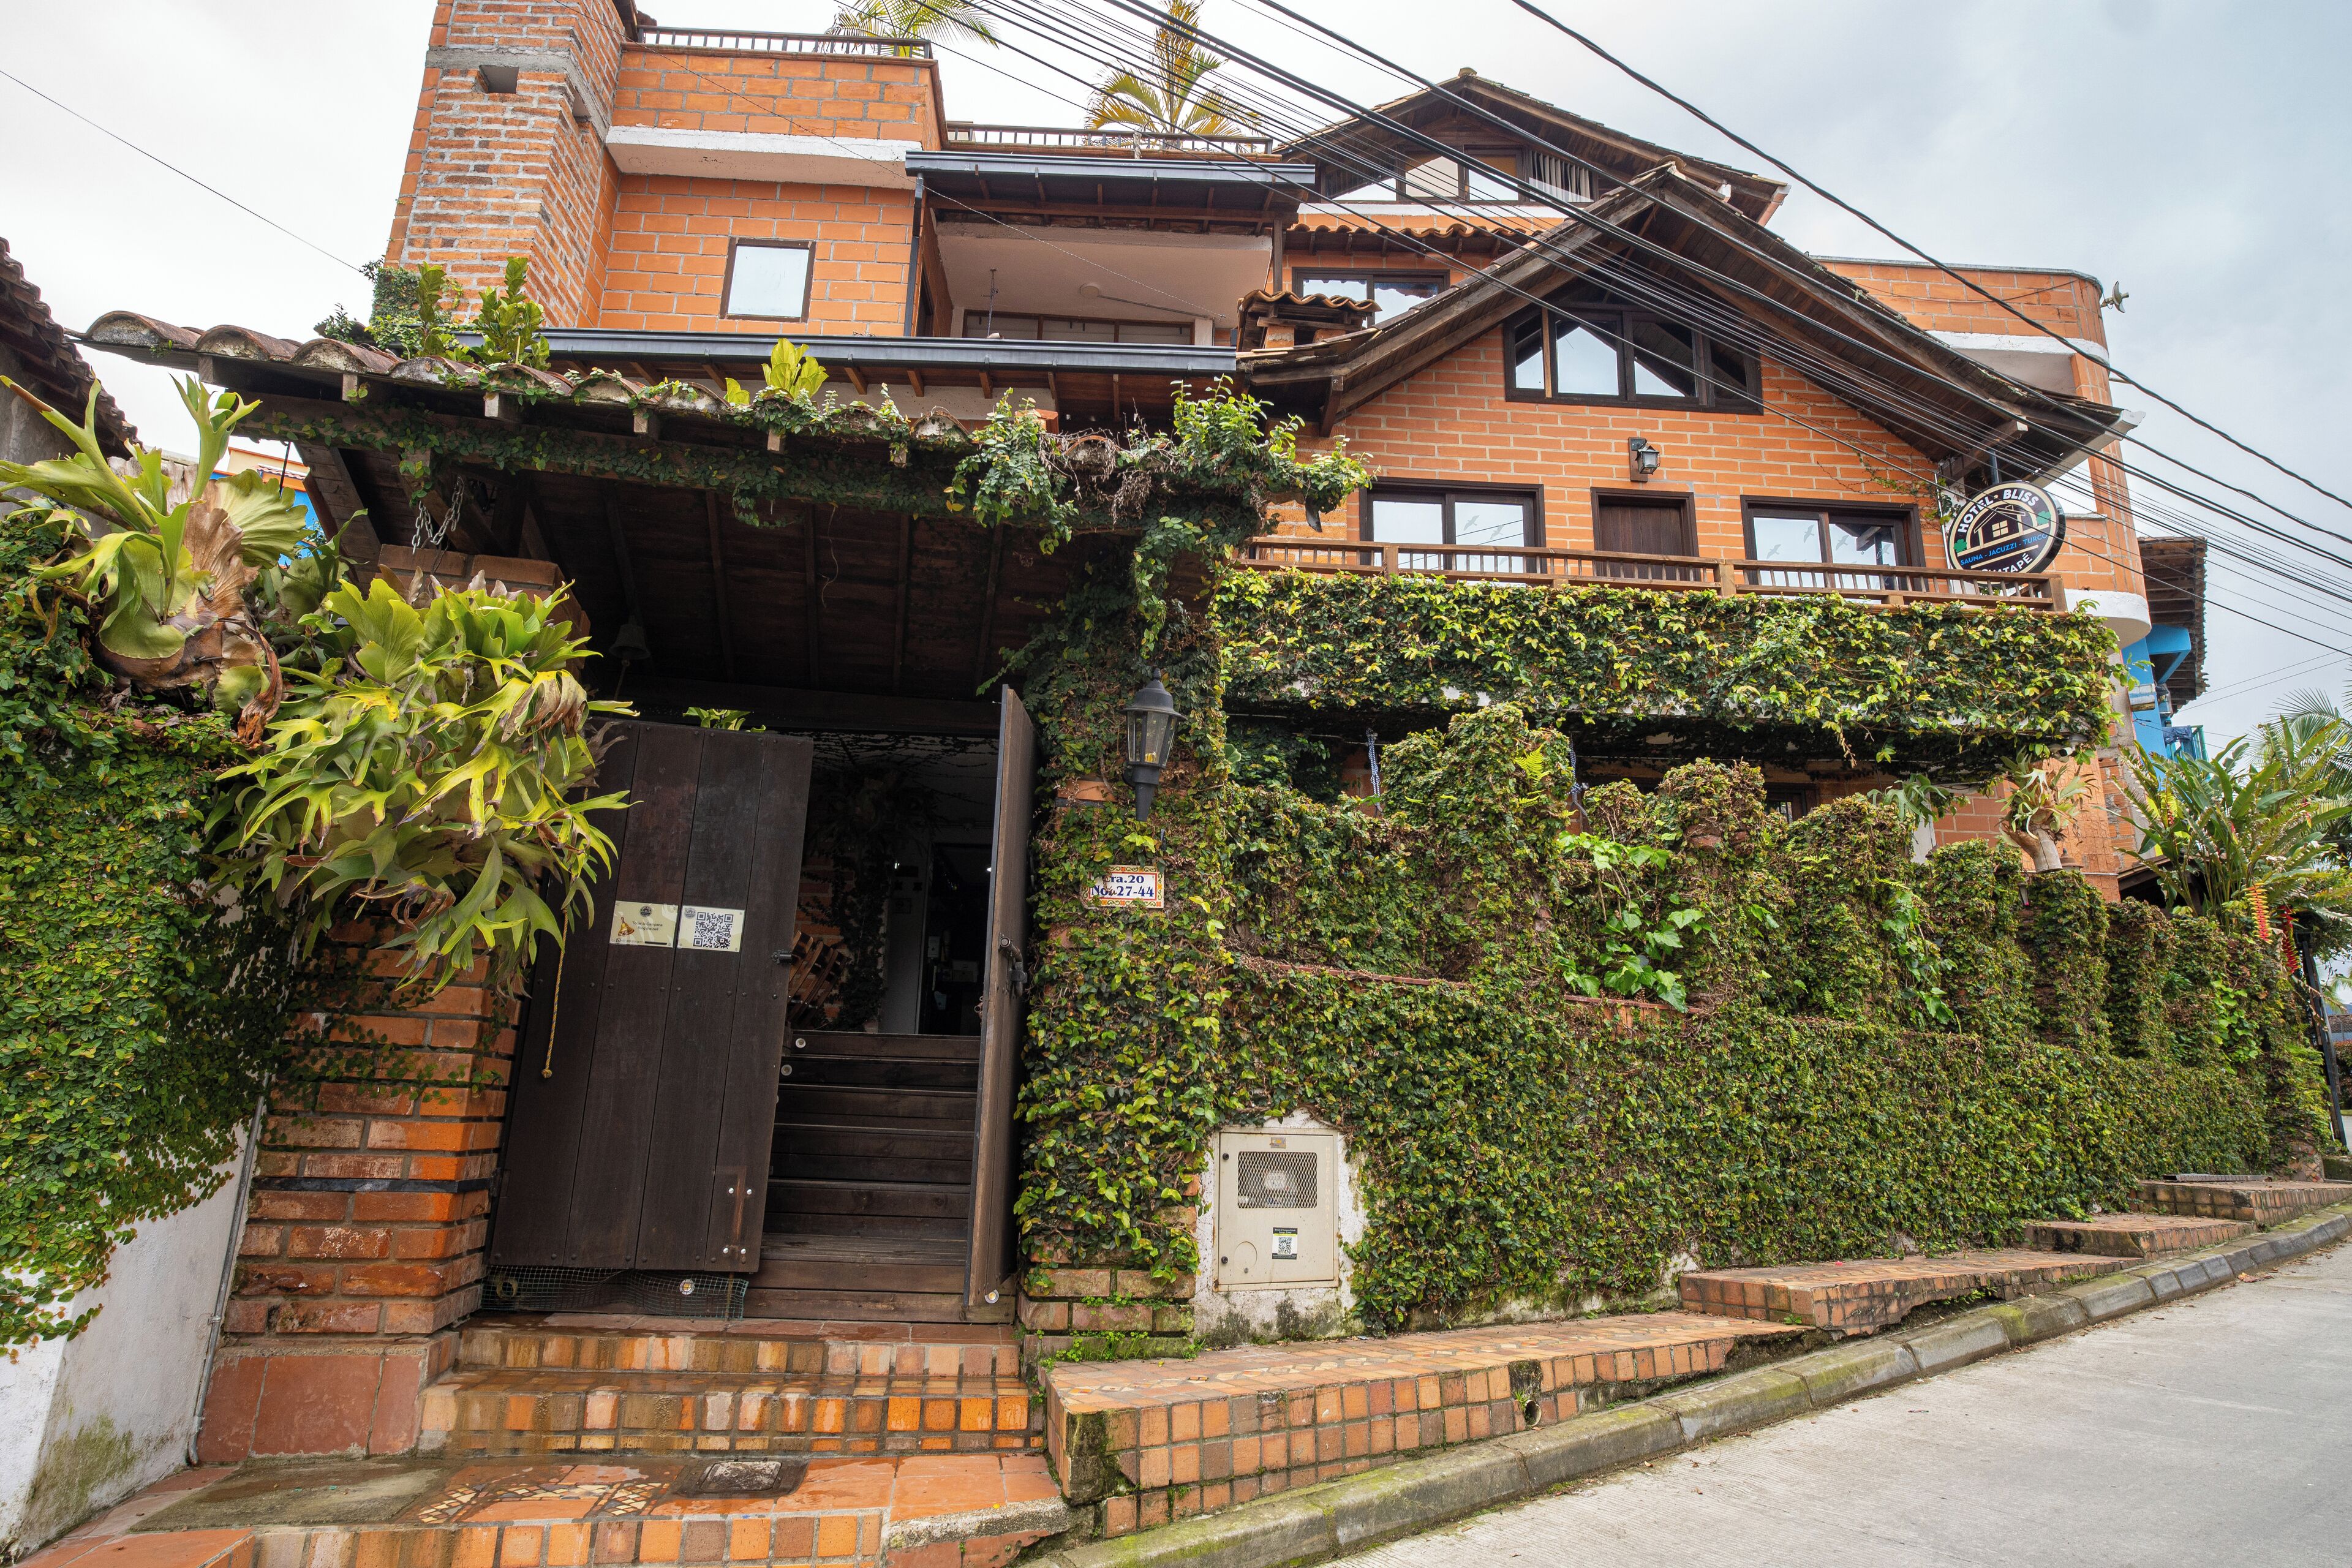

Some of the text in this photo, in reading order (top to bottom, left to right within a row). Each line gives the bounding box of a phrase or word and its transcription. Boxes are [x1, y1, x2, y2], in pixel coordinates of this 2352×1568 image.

[1957, 489, 2040, 533] HOTEL BLISS
[1960, 532, 2048, 566] SAUNA JACUZZI TURCO
[1981, 552, 2034, 573] TAPÉ
[1117, 886, 1155, 897] 27-44
